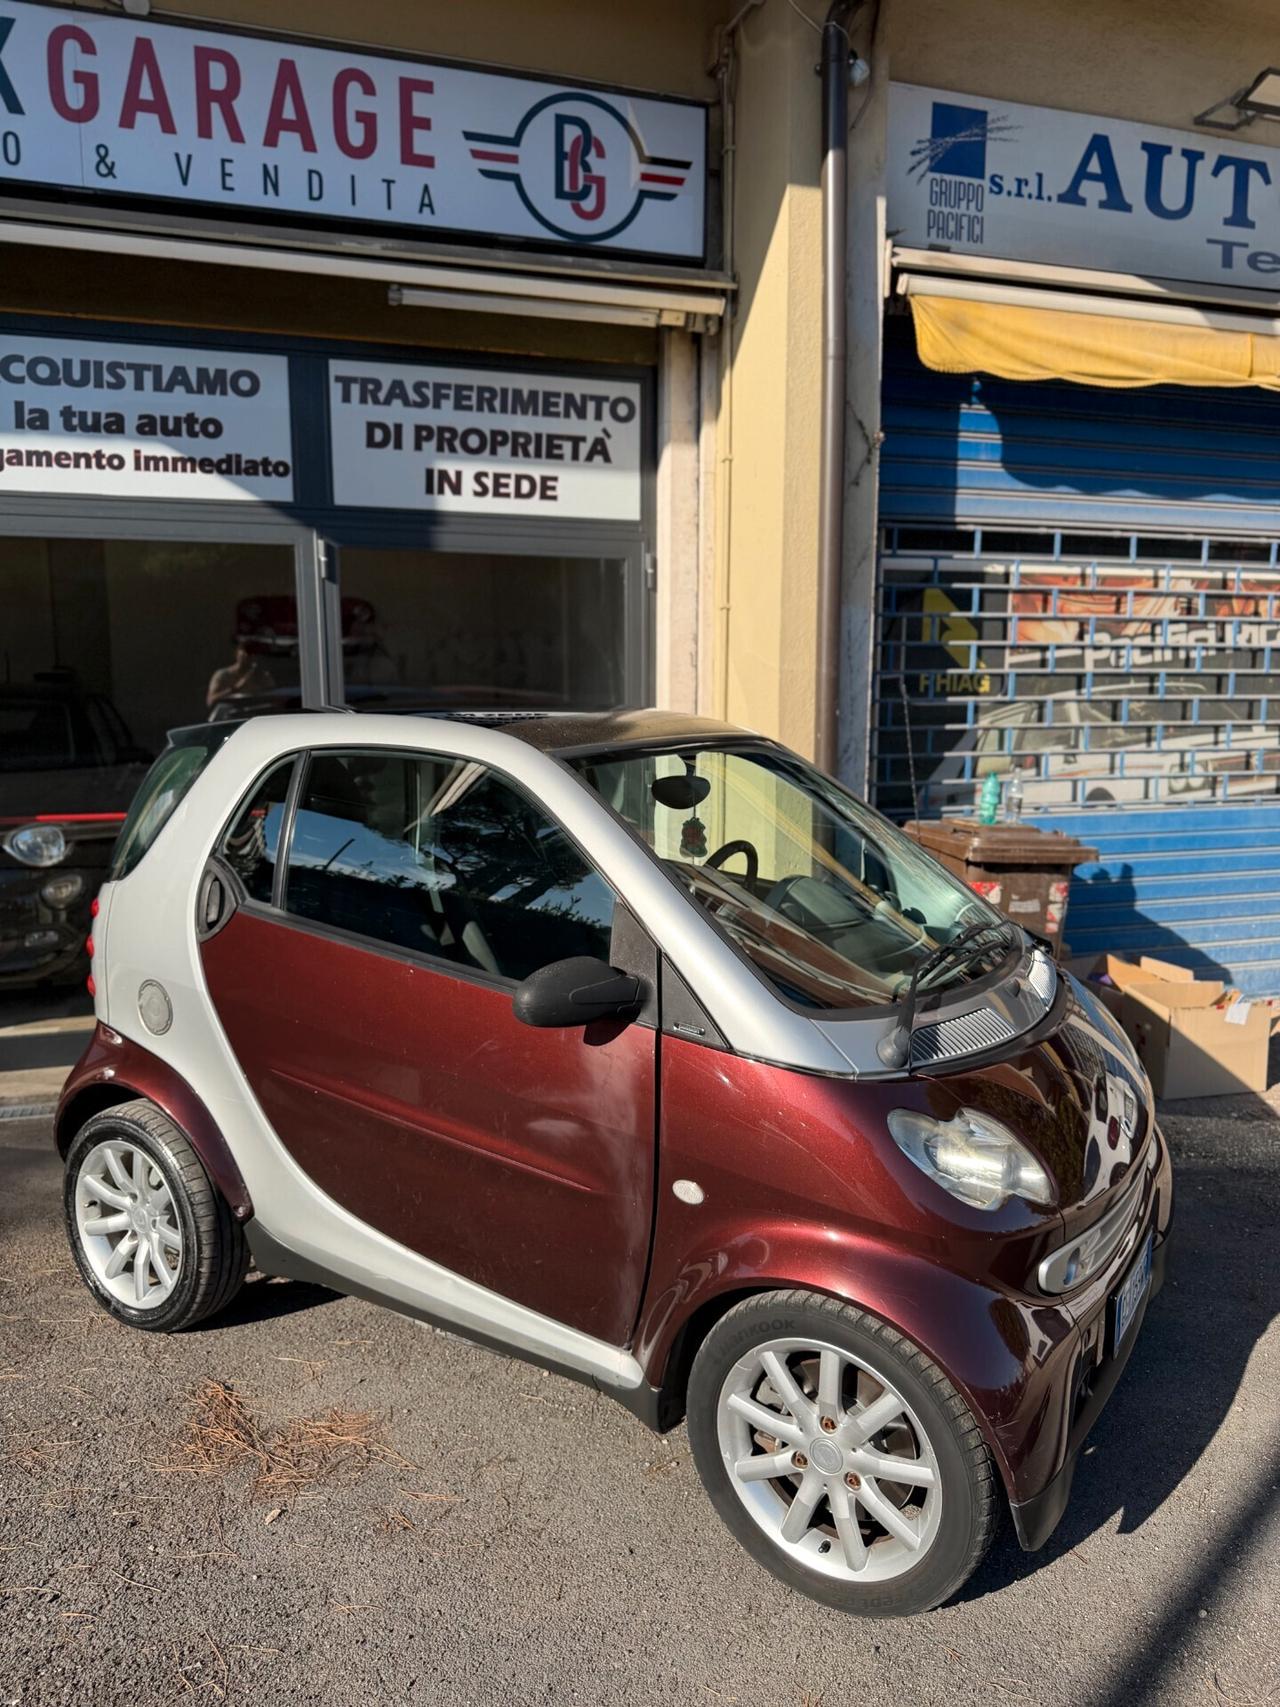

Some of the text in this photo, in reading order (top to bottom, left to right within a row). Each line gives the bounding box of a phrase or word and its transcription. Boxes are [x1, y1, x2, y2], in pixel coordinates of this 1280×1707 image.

[46, 23, 436, 169] GARAGE
[95, 143, 117, 179] &
[174, 151, 436, 216] VENDITA
[929, 177, 985, 213] GRUPPO
[988, 132, 1273, 230] s.r.l. AUT
[926, 208, 985, 245] PACIFICI
[1205, 237, 1280, 274] Te
[0, 353, 262, 399] CQUISTIAMO
[14, 400, 224, 440] la tua auto
[334, 374, 637, 425] TRASFERIMENTO
[365, 420, 613, 464] DI PROPRIETÀ
[133, 449, 291, 478] immediato
[425, 467, 559, 502] IN SEDE
